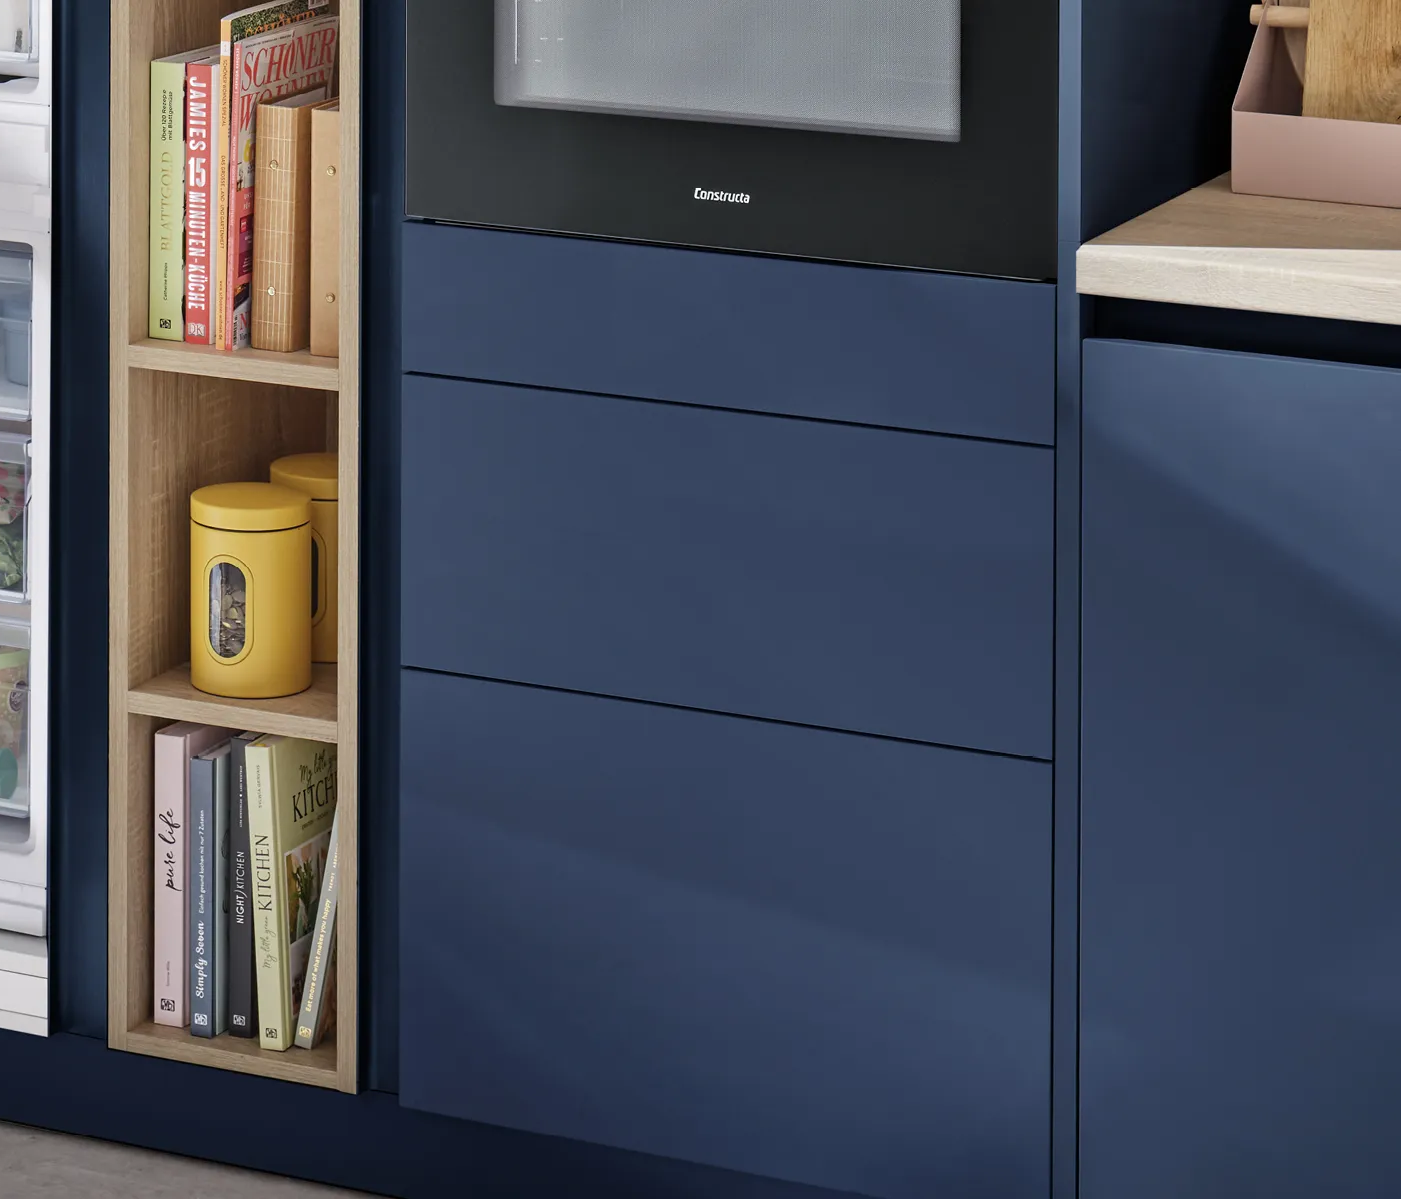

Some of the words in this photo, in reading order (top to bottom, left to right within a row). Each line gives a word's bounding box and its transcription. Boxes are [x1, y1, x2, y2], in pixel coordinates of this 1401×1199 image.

[190, 75, 207, 152] JAMIES
[188, 157, 207, 187] 15
[160, 151, 174, 252] BLATTGOLD
[694, 187, 750, 204] Constructa
[188, 191, 207, 311] MINUTEN-KÜCHE
[188, 323, 204, 336] DK
[292, 771, 337, 822] KITCH
[158, 808, 181, 846] life
[166, 851, 182, 891] pure
[255, 834, 273, 911] KITCHEN
[320, 898, 332, 921] happy
[319, 920, 328, 934] you
[314, 932, 325, 956] makes
[310, 972, 318, 982] of
[311, 955, 320, 973] what
[194, 957, 208, 999] Simply
[307, 981, 316, 999] more
[304, 998, 313, 1012] Eat
